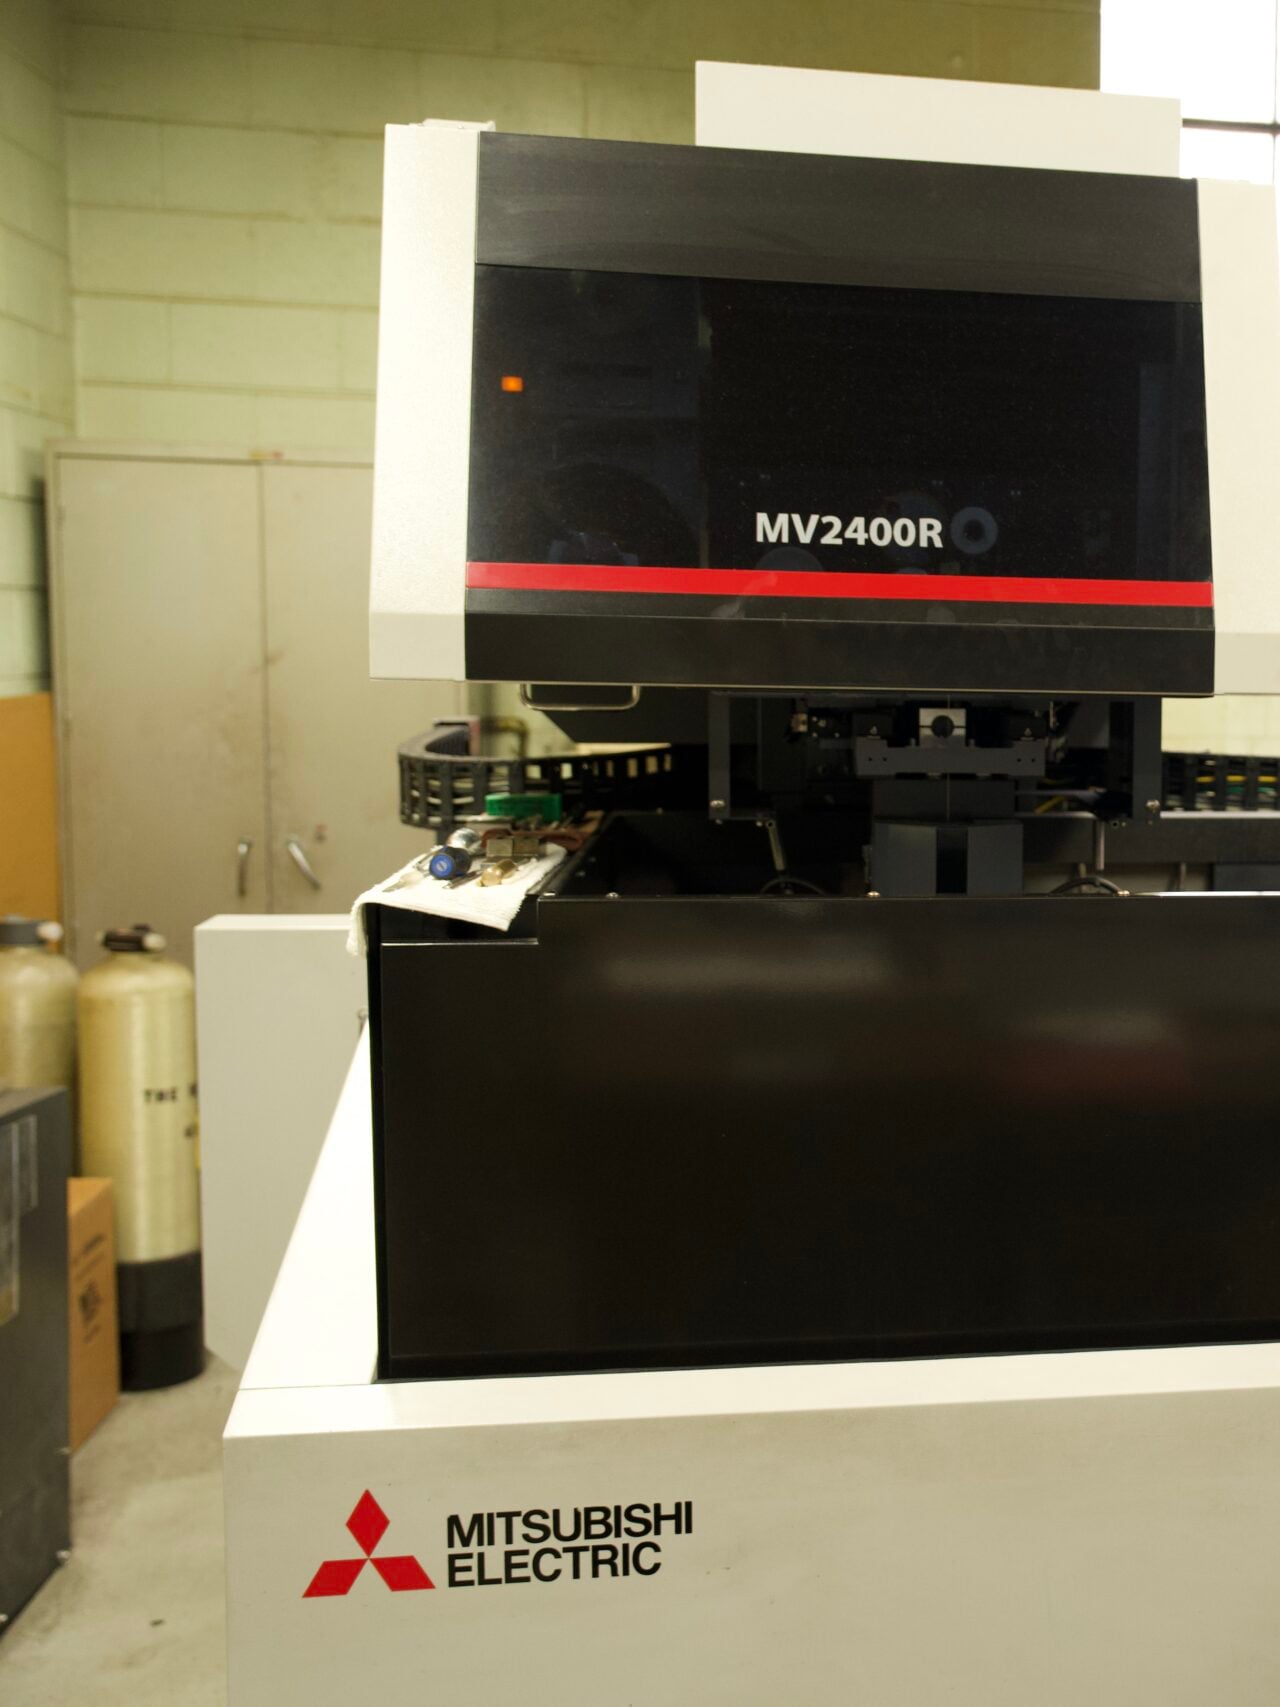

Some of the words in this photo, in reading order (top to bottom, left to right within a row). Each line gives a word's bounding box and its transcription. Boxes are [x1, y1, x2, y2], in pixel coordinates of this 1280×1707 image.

[756, 512, 943, 548] MV2400R
[447, 1501, 692, 1548] MITSUBISHI
[448, 1541, 661, 1588] ELECTRIC
